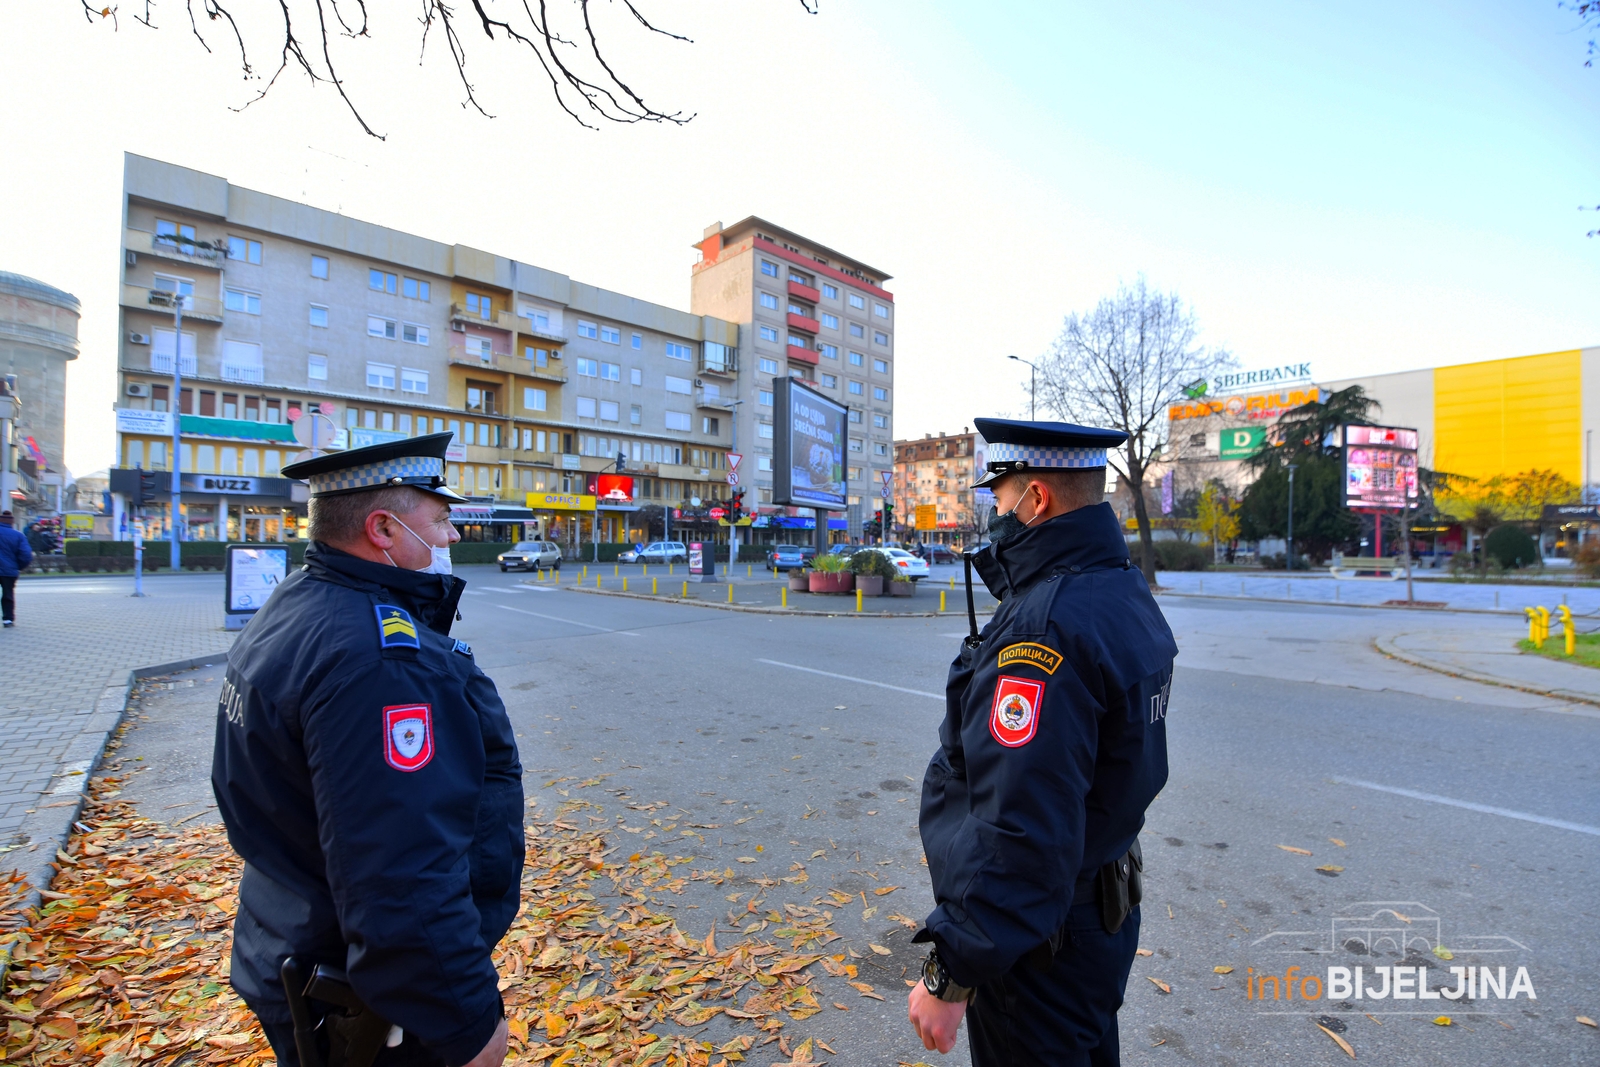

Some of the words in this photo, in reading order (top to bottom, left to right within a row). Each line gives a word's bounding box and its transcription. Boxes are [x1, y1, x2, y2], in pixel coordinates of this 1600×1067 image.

[1214, 362, 1311, 388] SBERBANK
[1169, 388, 1319, 420] EMPORIUM
[1233, 431, 1252, 447] D
[204, 479, 251, 491] BUZZ
[545, 495, 580, 505] OFFICE
[804, 519, 816, 528] Apo
[1003, 647, 1055, 667] ПОЛИЦИЈА
